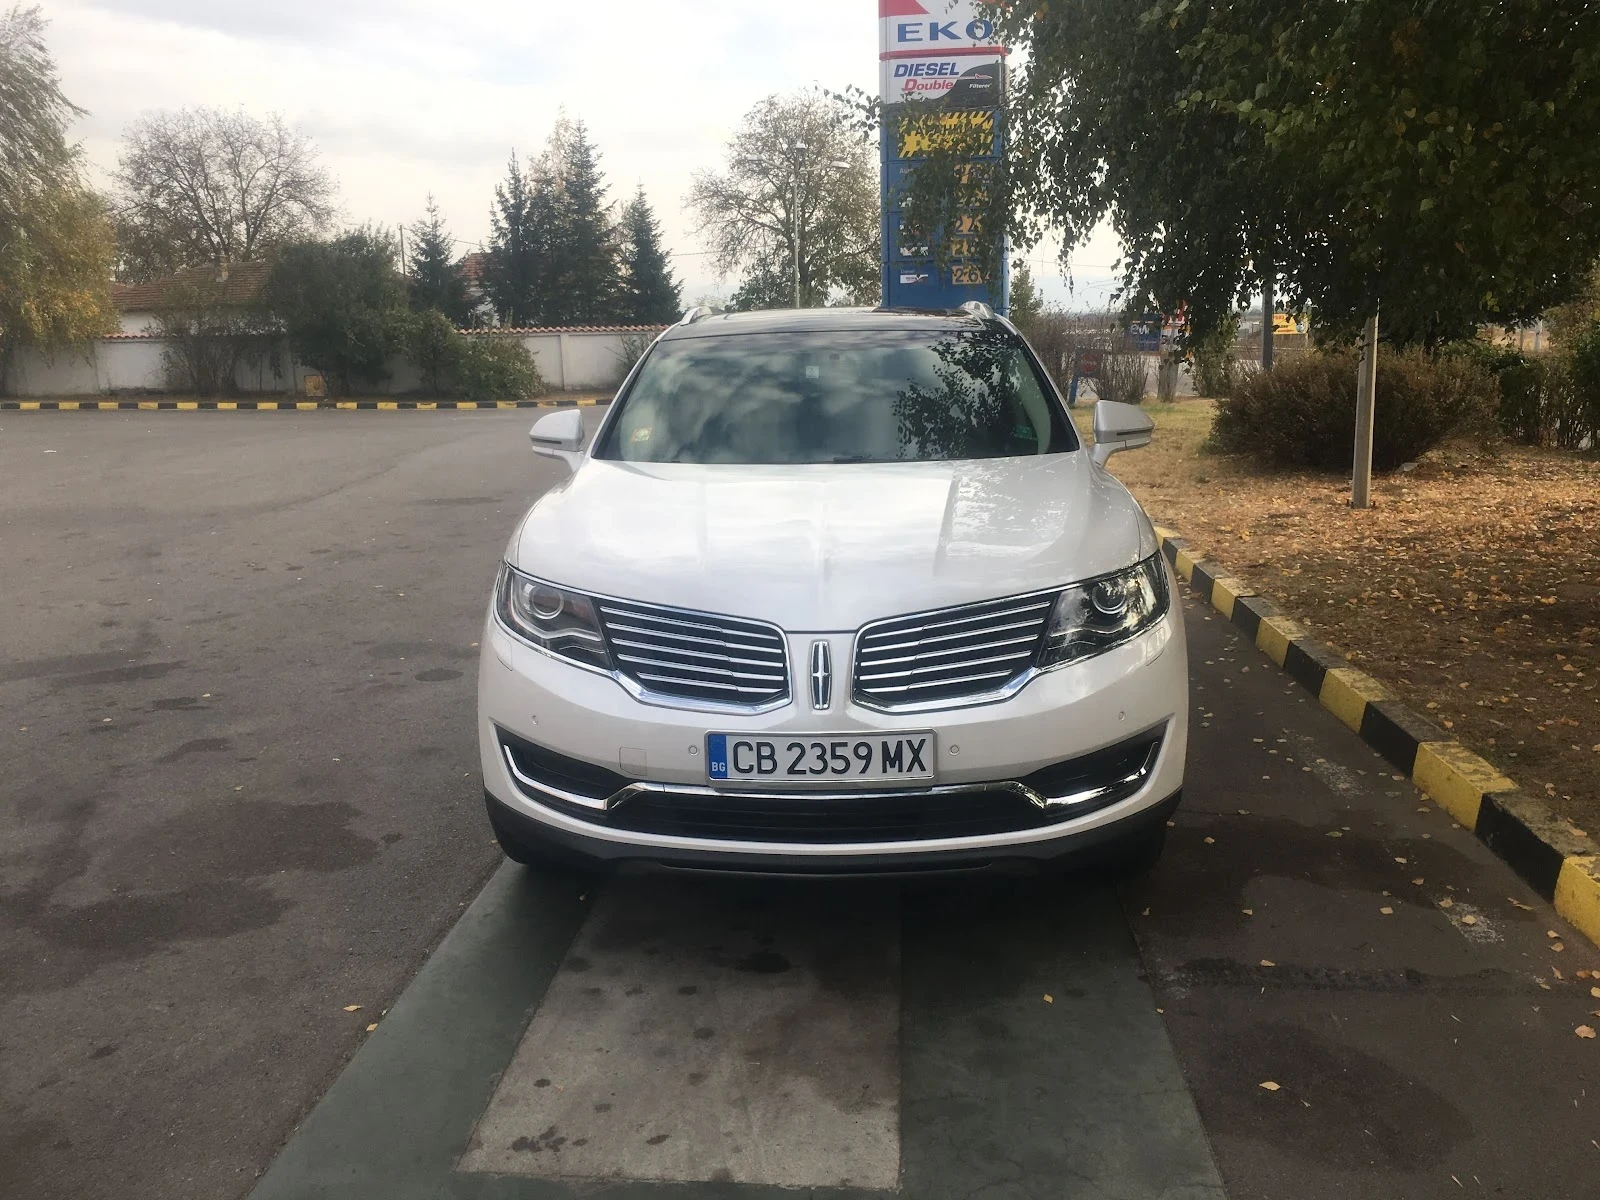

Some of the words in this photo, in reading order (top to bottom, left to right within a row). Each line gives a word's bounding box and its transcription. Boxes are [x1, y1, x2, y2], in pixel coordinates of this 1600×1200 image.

[897, 19, 993, 42] EKO
[893, 62, 960, 78] DIESEL
[904, 78, 954, 92] Double
[732, 740, 778, 774] CB
[786, 741, 873, 775] 2359
[881, 738, 927, 774] MX
[711, 761, 726, 772] BG
